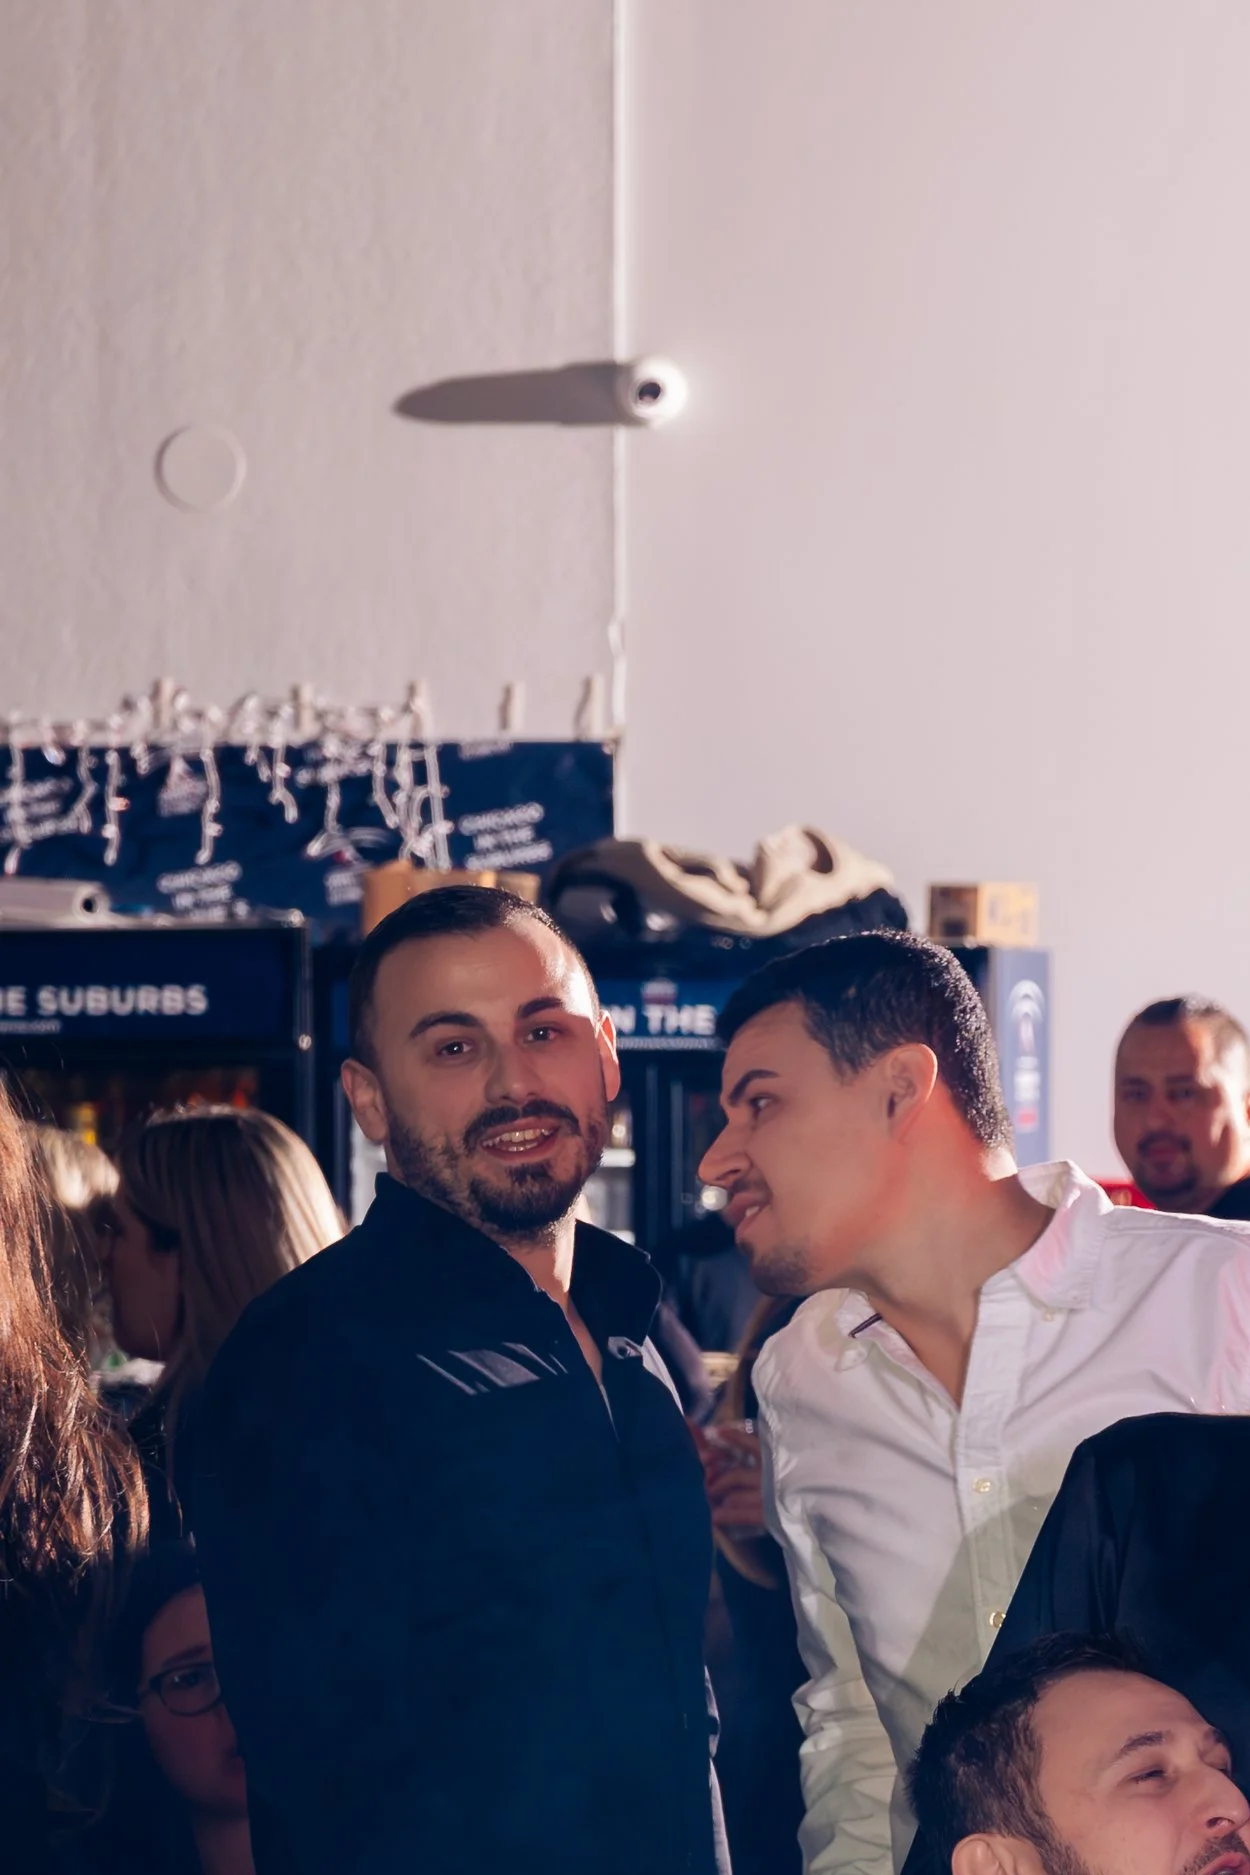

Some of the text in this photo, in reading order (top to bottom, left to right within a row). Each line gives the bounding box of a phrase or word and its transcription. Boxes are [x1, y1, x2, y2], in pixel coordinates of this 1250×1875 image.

[0, 984, 208, 1016] E SUBURBS
[642, 1003, 717, 1035] THE
